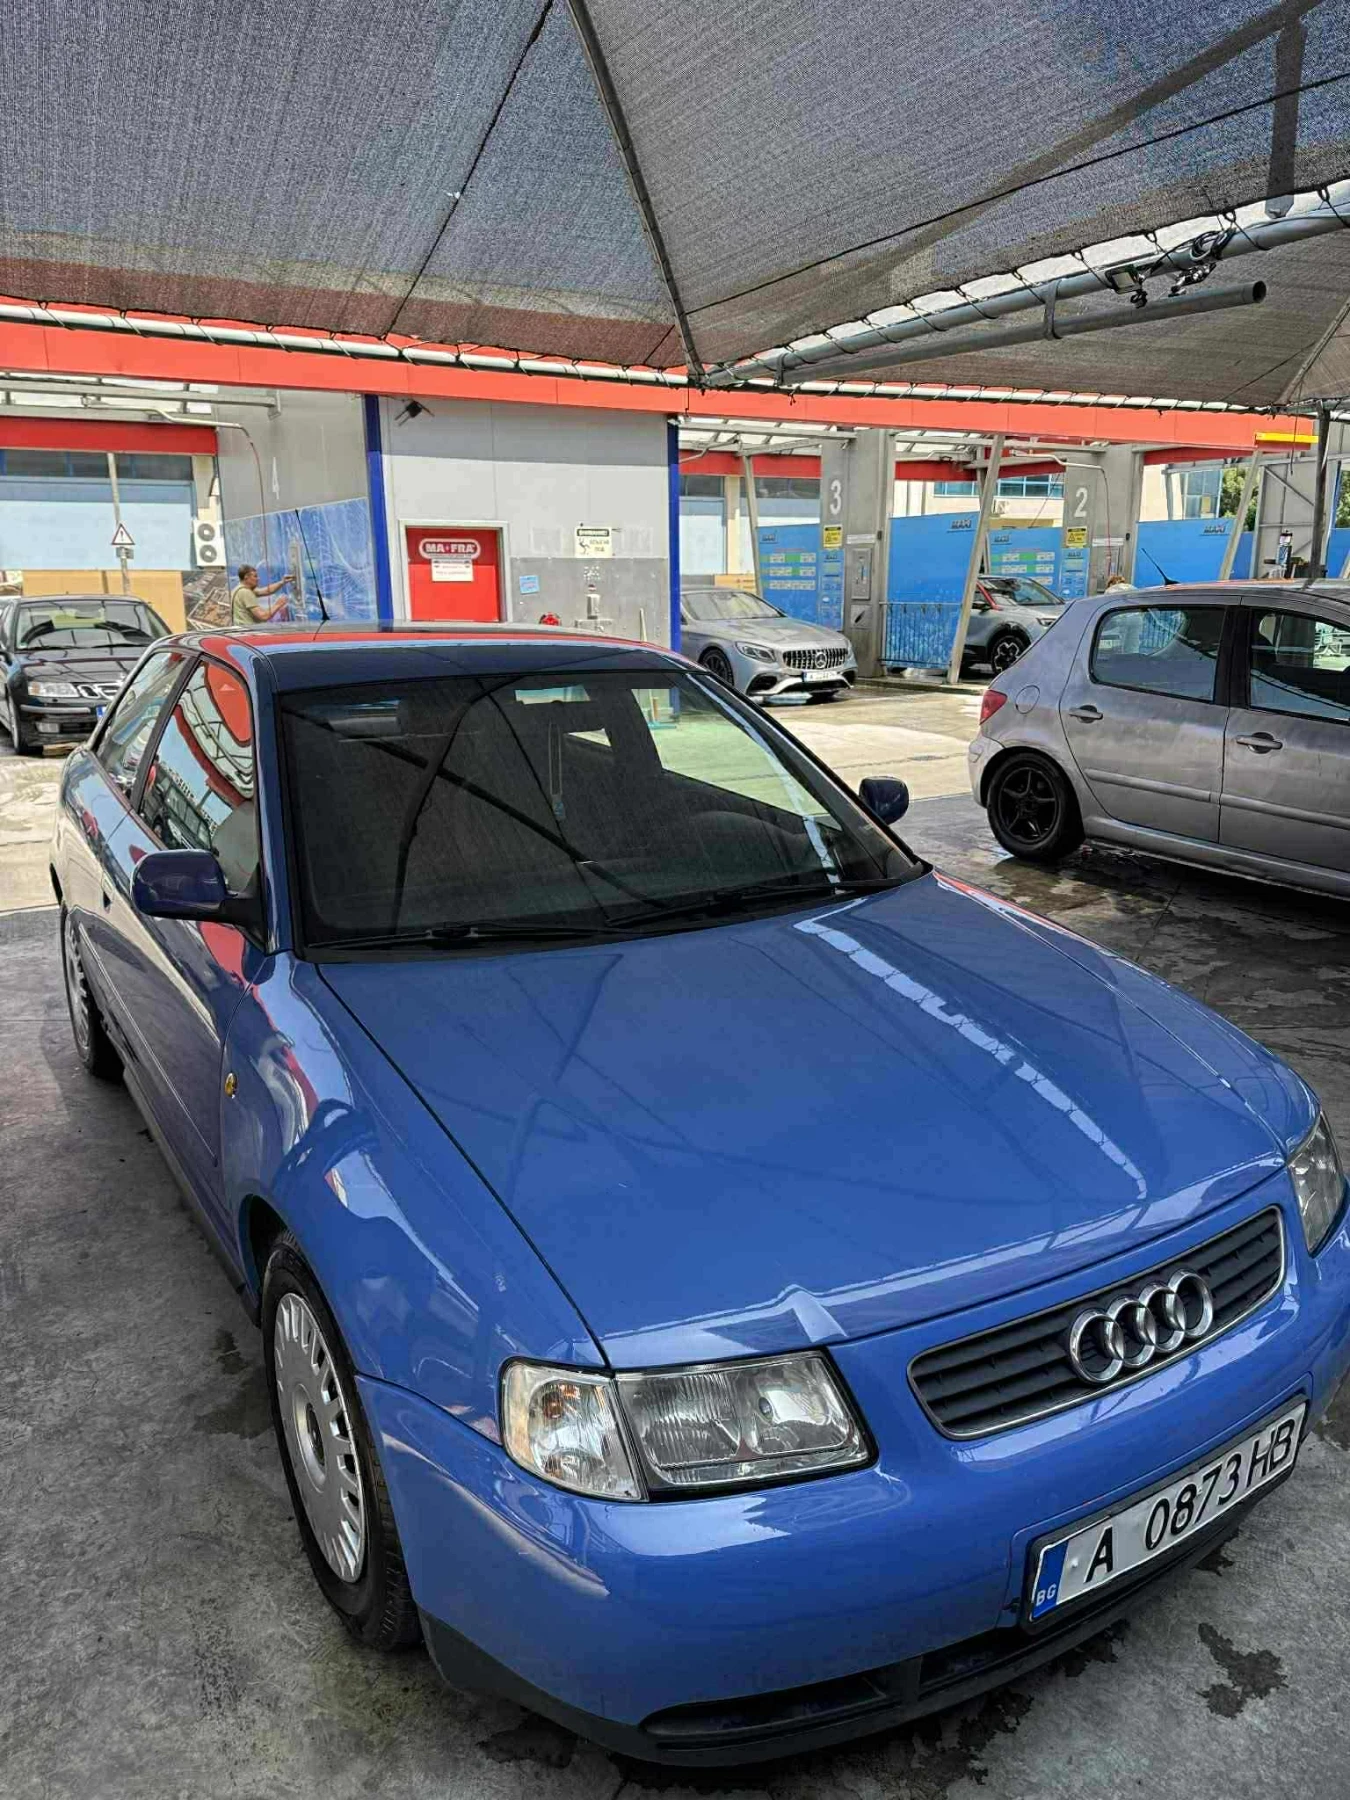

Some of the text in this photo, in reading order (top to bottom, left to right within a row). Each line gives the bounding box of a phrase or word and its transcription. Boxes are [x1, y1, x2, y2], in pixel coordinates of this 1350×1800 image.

[830, 479, 841, 515] 3
[1074, 487, 1088, 517] 2
[1083, 1418, 1295, 1583] A 0873 HB
[1036, 1583, 1057, 1606] BG
